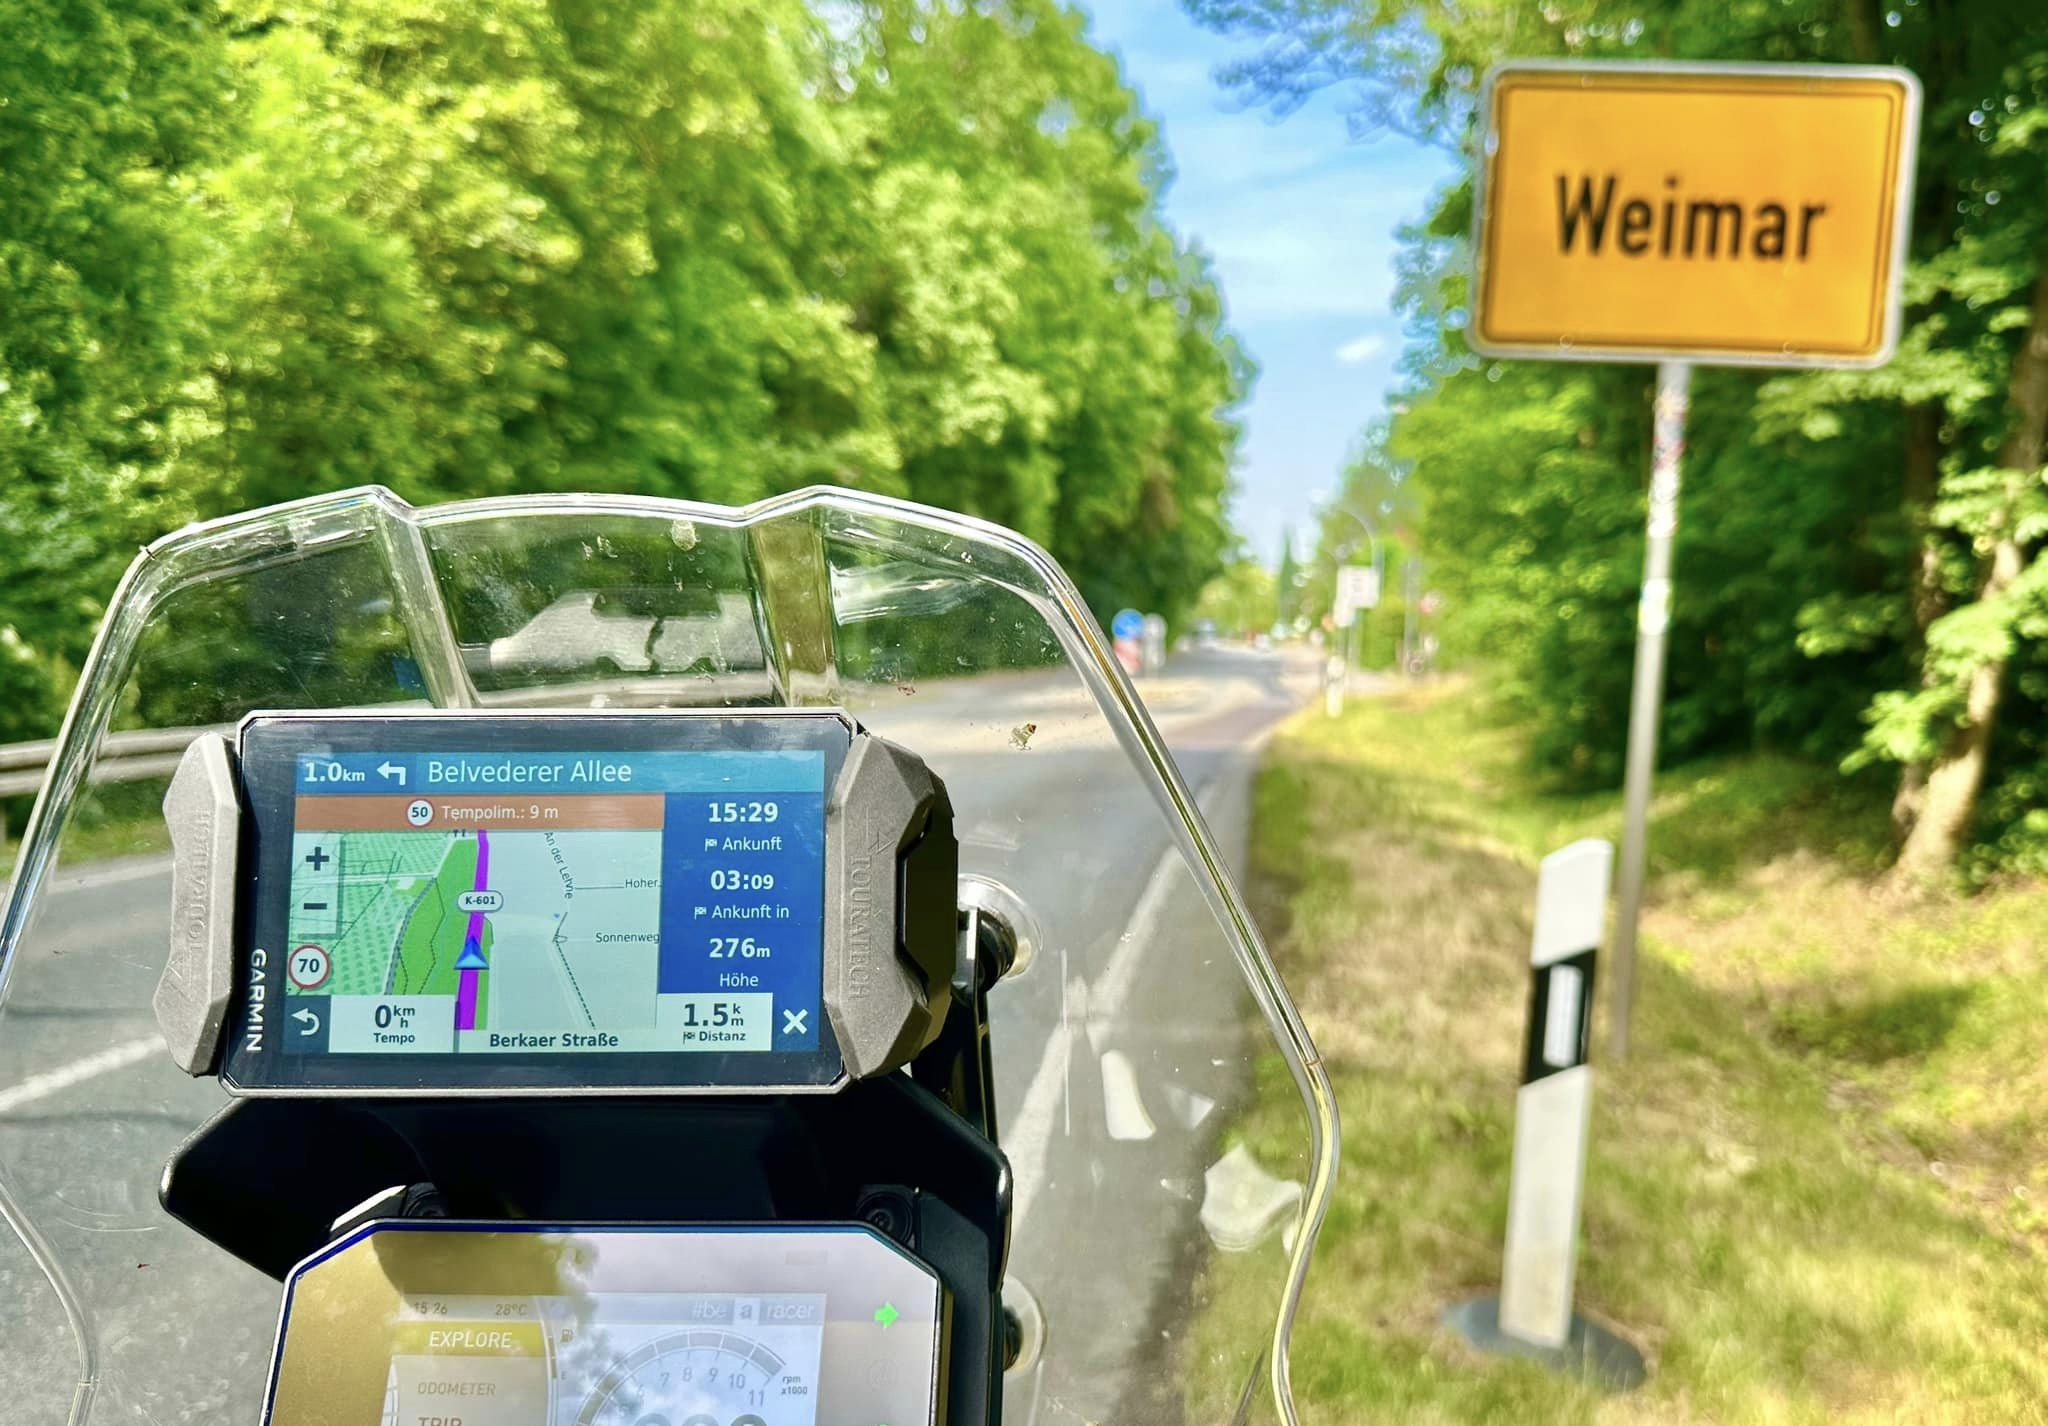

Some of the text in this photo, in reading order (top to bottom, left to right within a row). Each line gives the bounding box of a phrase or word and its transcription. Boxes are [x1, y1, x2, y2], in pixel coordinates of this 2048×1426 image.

[1556, 172, 1830, 261] Weimar
[303, 762, 366, 783] 1.0km
[428, 760, 633, 783] Belvederer Allee
[411, 806, 429, 818] 50
[441, 805, 559, 821] Tempolim.: 9 m
[708, 802, 779, 823] 15:29
[544, 832, 556, 847] An
[551, 848, 565, 865] der
[722, 837, 783, 851] Ankunft
[710, 870, 775, 891] 03:09
[465, 896, 496, 905] K-601
[711, 904, 790, 919] Ankunft in
[850, 855, 872, 1000] TOURATECH
[595, 932, 660, 944] Sonnenweg
[708, 938, 771, 958] 276m
[299, 958, 320, 972] 70
[719, 973, 759, 988] Höhe
[246, 948, 267, 1052] GARMIN
[374, 1004, 392, 1028] 0
[683, 1003, 729, 1027] 1.5
[374, 1032, 416, 1044] Tempo
[489, 1033, 619, 1047] Berkaer Straße
[699, 1031, 746, 1042] Distanz
[414, 1302, 448, 1315] 1526
[495, 1303, 527, 1316] 28°C
[767, 1303, 815, 1319] racer
[429, 1331, 513, 1348] EXPLORE
[660, 1372, 670, 1388] 7
[682, 1368, 693, 1382] 8
[708, 1368, 718, 1384] 9
[728, 1373, 746, 1389] 10
[782, 1375, 801, 1385] rpm
[417, 1382, 497, 1396] ODOMETER
[781, 1386, 808, 1395] x1000
[748, 1389, 765, 1407] 11
